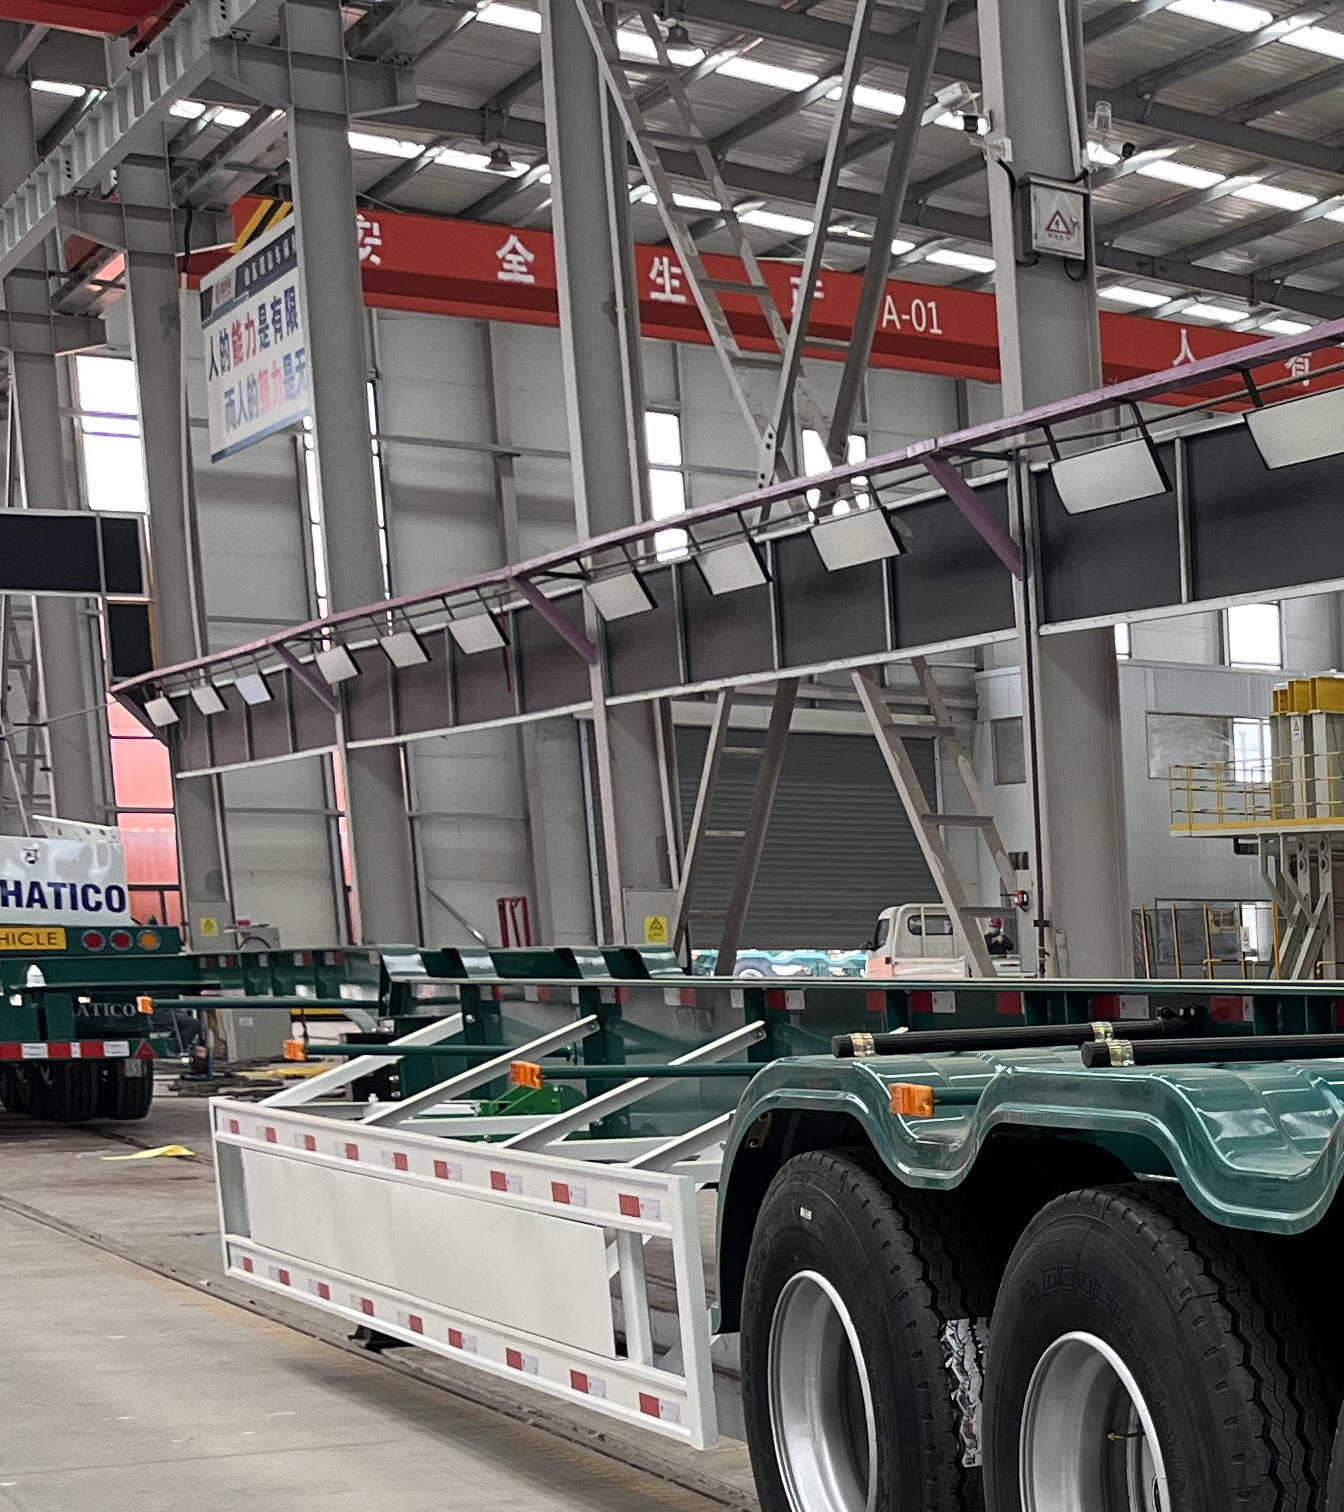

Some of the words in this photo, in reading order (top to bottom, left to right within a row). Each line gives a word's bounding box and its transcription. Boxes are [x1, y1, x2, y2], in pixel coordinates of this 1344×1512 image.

[496, 235, 535, 284] 全
[650, 256, 687, 302] 生
[882, 295, 943, 335] A-01
